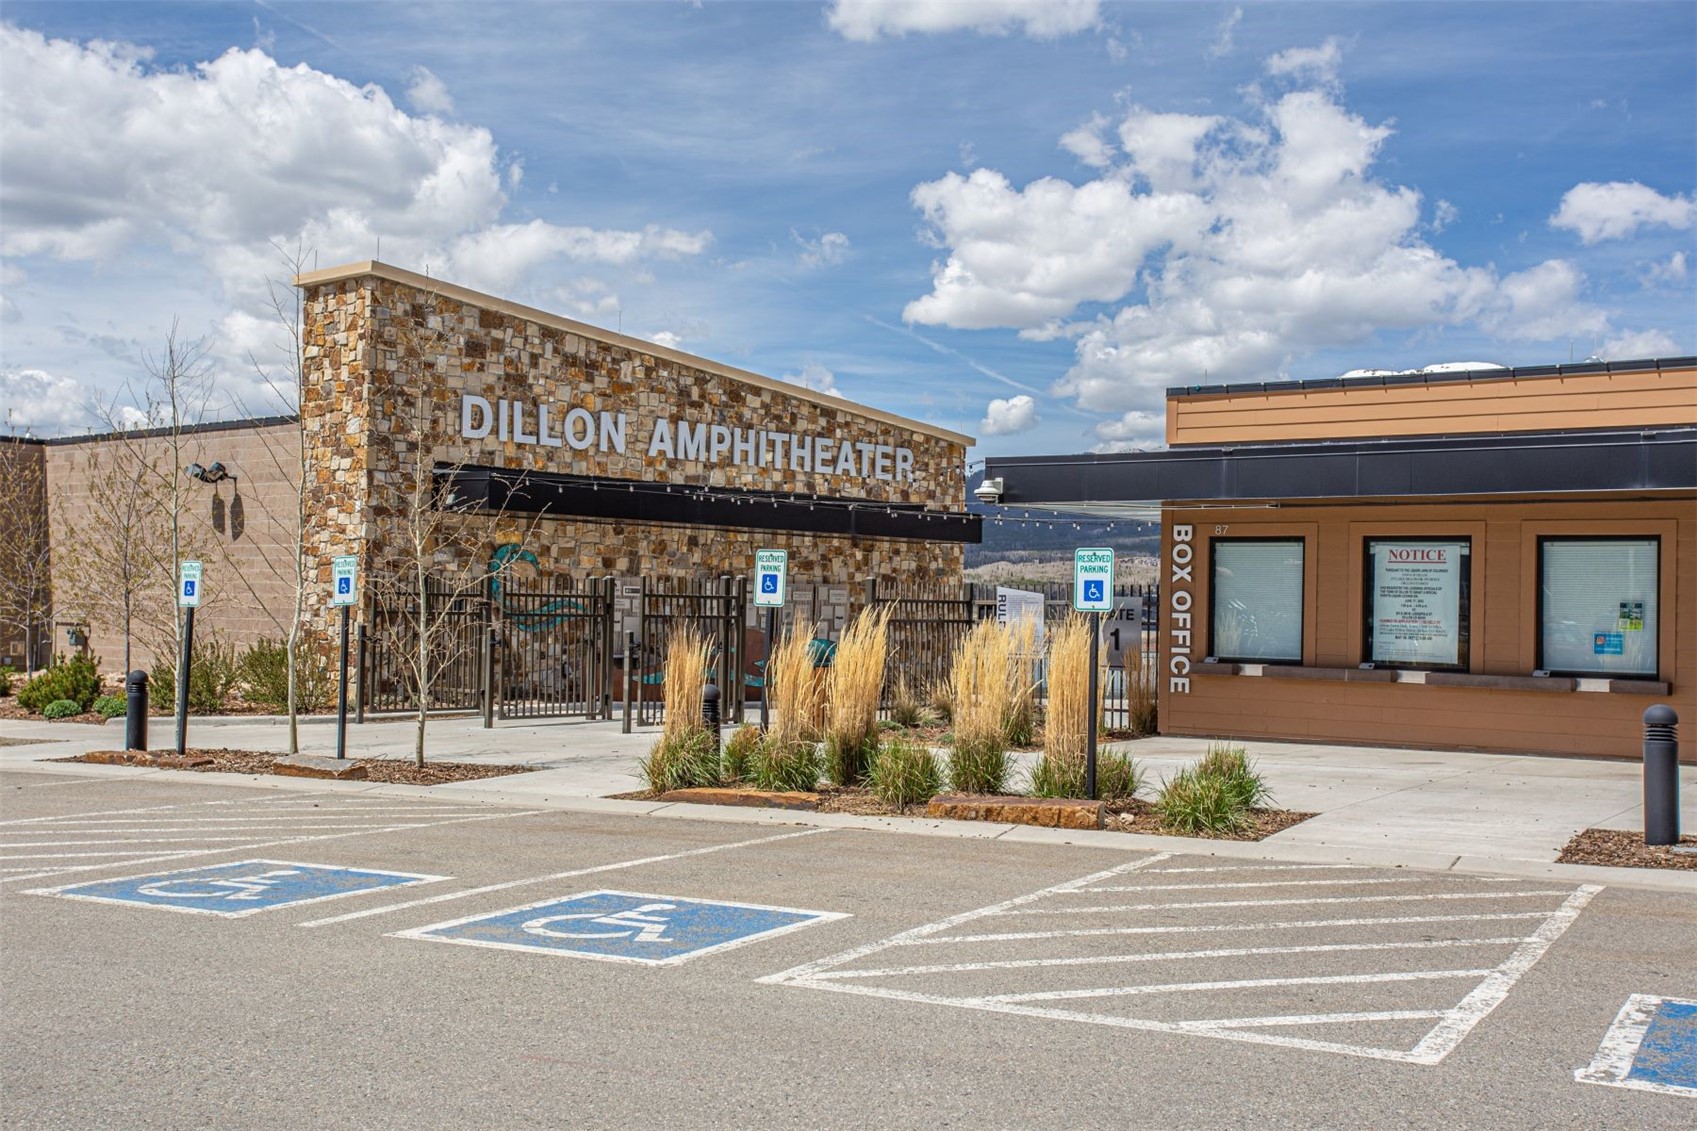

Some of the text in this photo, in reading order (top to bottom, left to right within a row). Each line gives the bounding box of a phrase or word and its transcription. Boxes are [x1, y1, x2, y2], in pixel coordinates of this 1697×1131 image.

[462, 395, 915, 482] DILLON AMPHITHEATER
[1214, 525, 1229, 535] 87
[758, 555, 784, 563] RESERVED
[1078, 554, 1111, 563] RESERVED
[1389, 549, 1446, 561] NOTICE
[760, 564, 782, 572] PARKING
[1080, 564, 1109, 573] PARKING
[1170, 524, 1193, 694] BOX OFFICE
[1110, 628, 1120, 651] 1
